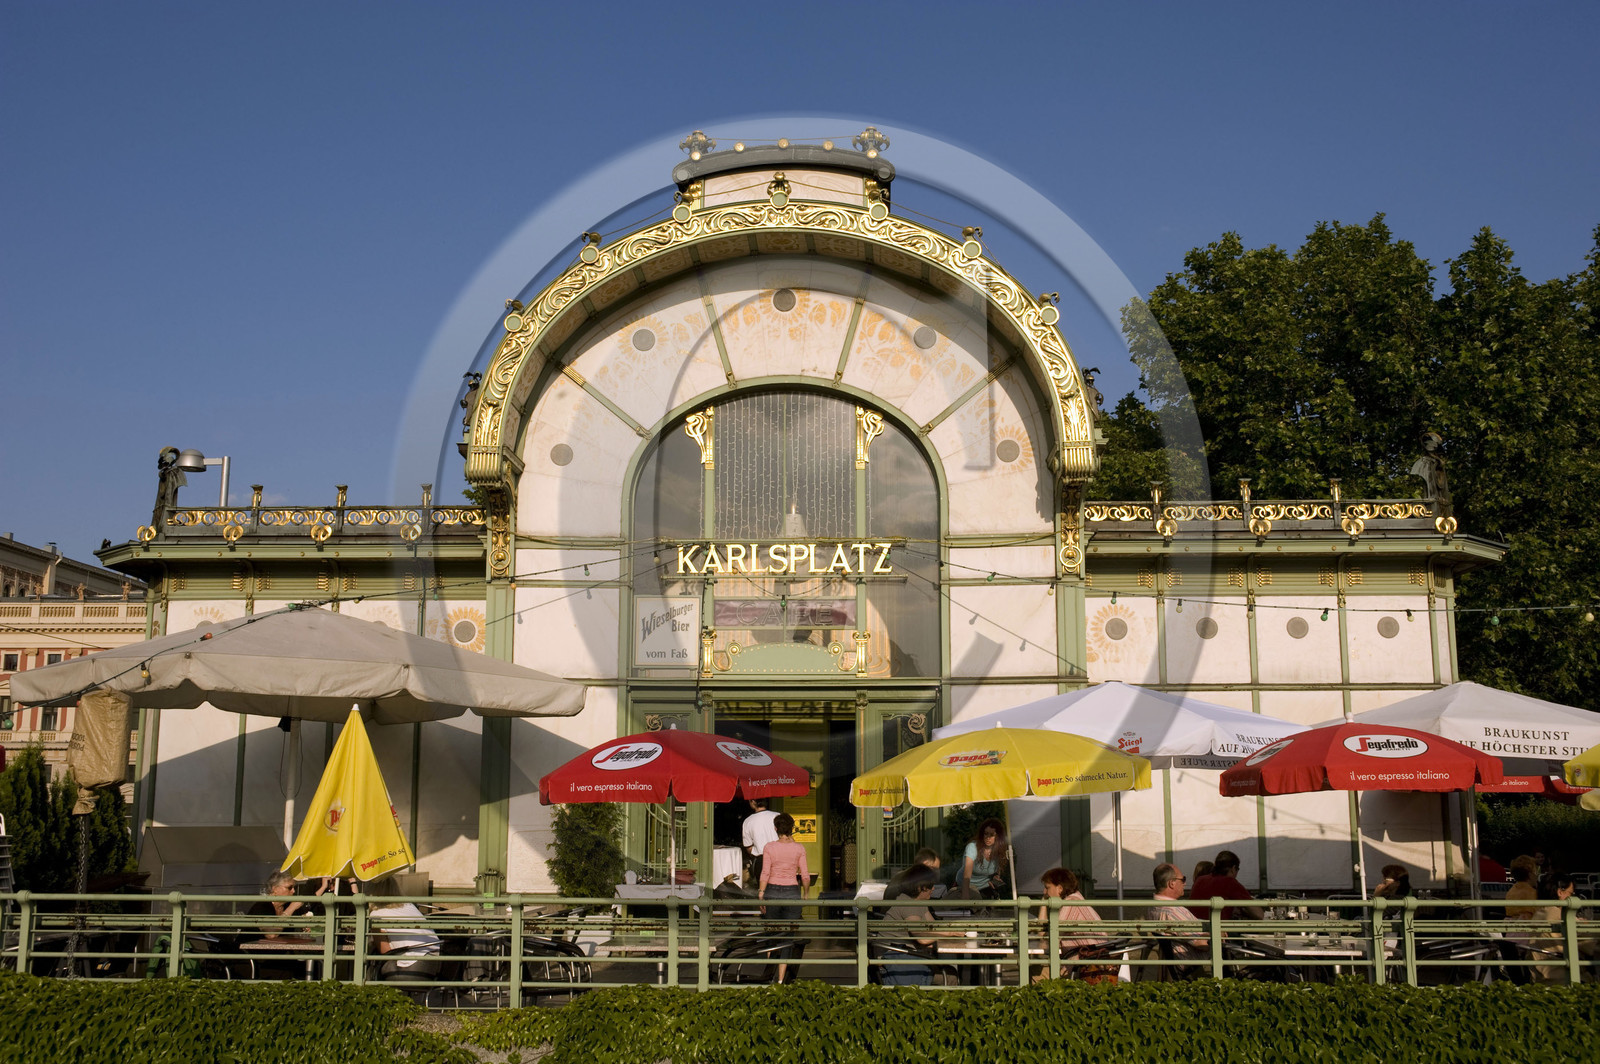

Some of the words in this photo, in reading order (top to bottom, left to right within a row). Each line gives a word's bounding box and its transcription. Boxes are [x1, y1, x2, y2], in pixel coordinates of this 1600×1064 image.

[677, 543, 893, 573] KARLSPLATZ
[641, 603, 694, 643] Wieselburger
[671, 619, 690, 632] Bier
[646, 650, 667, 659] vom
[671, 648, 689, 659] Faß
[1484, 727, 1570, 741] BRAUKUNST
[1117, 737, 1142, 749] Stiegl
[1218, 743, 1239, 753] AUF
[1356, 737, 1418, 752] Segafredo
[1482, 740, 1558, 755] HÖCHSTER
[1065, 775, 1074, 783] So
[1075, 772, 1105, 781] schmeckt
[1106, 771, 1128, 779] Natur.
[1349, 771, 1356, 780] il
[1378, 772, 1414, 782] espresso
[1417, 770, 1450, 780] italiano
[570, 782, 575, 792] il
[577, 784, 593, 792] vero
[594, 783, 625, 793] espresso
[626, 781, 653, 791] italiano
[388, 850, 397, 859] So
